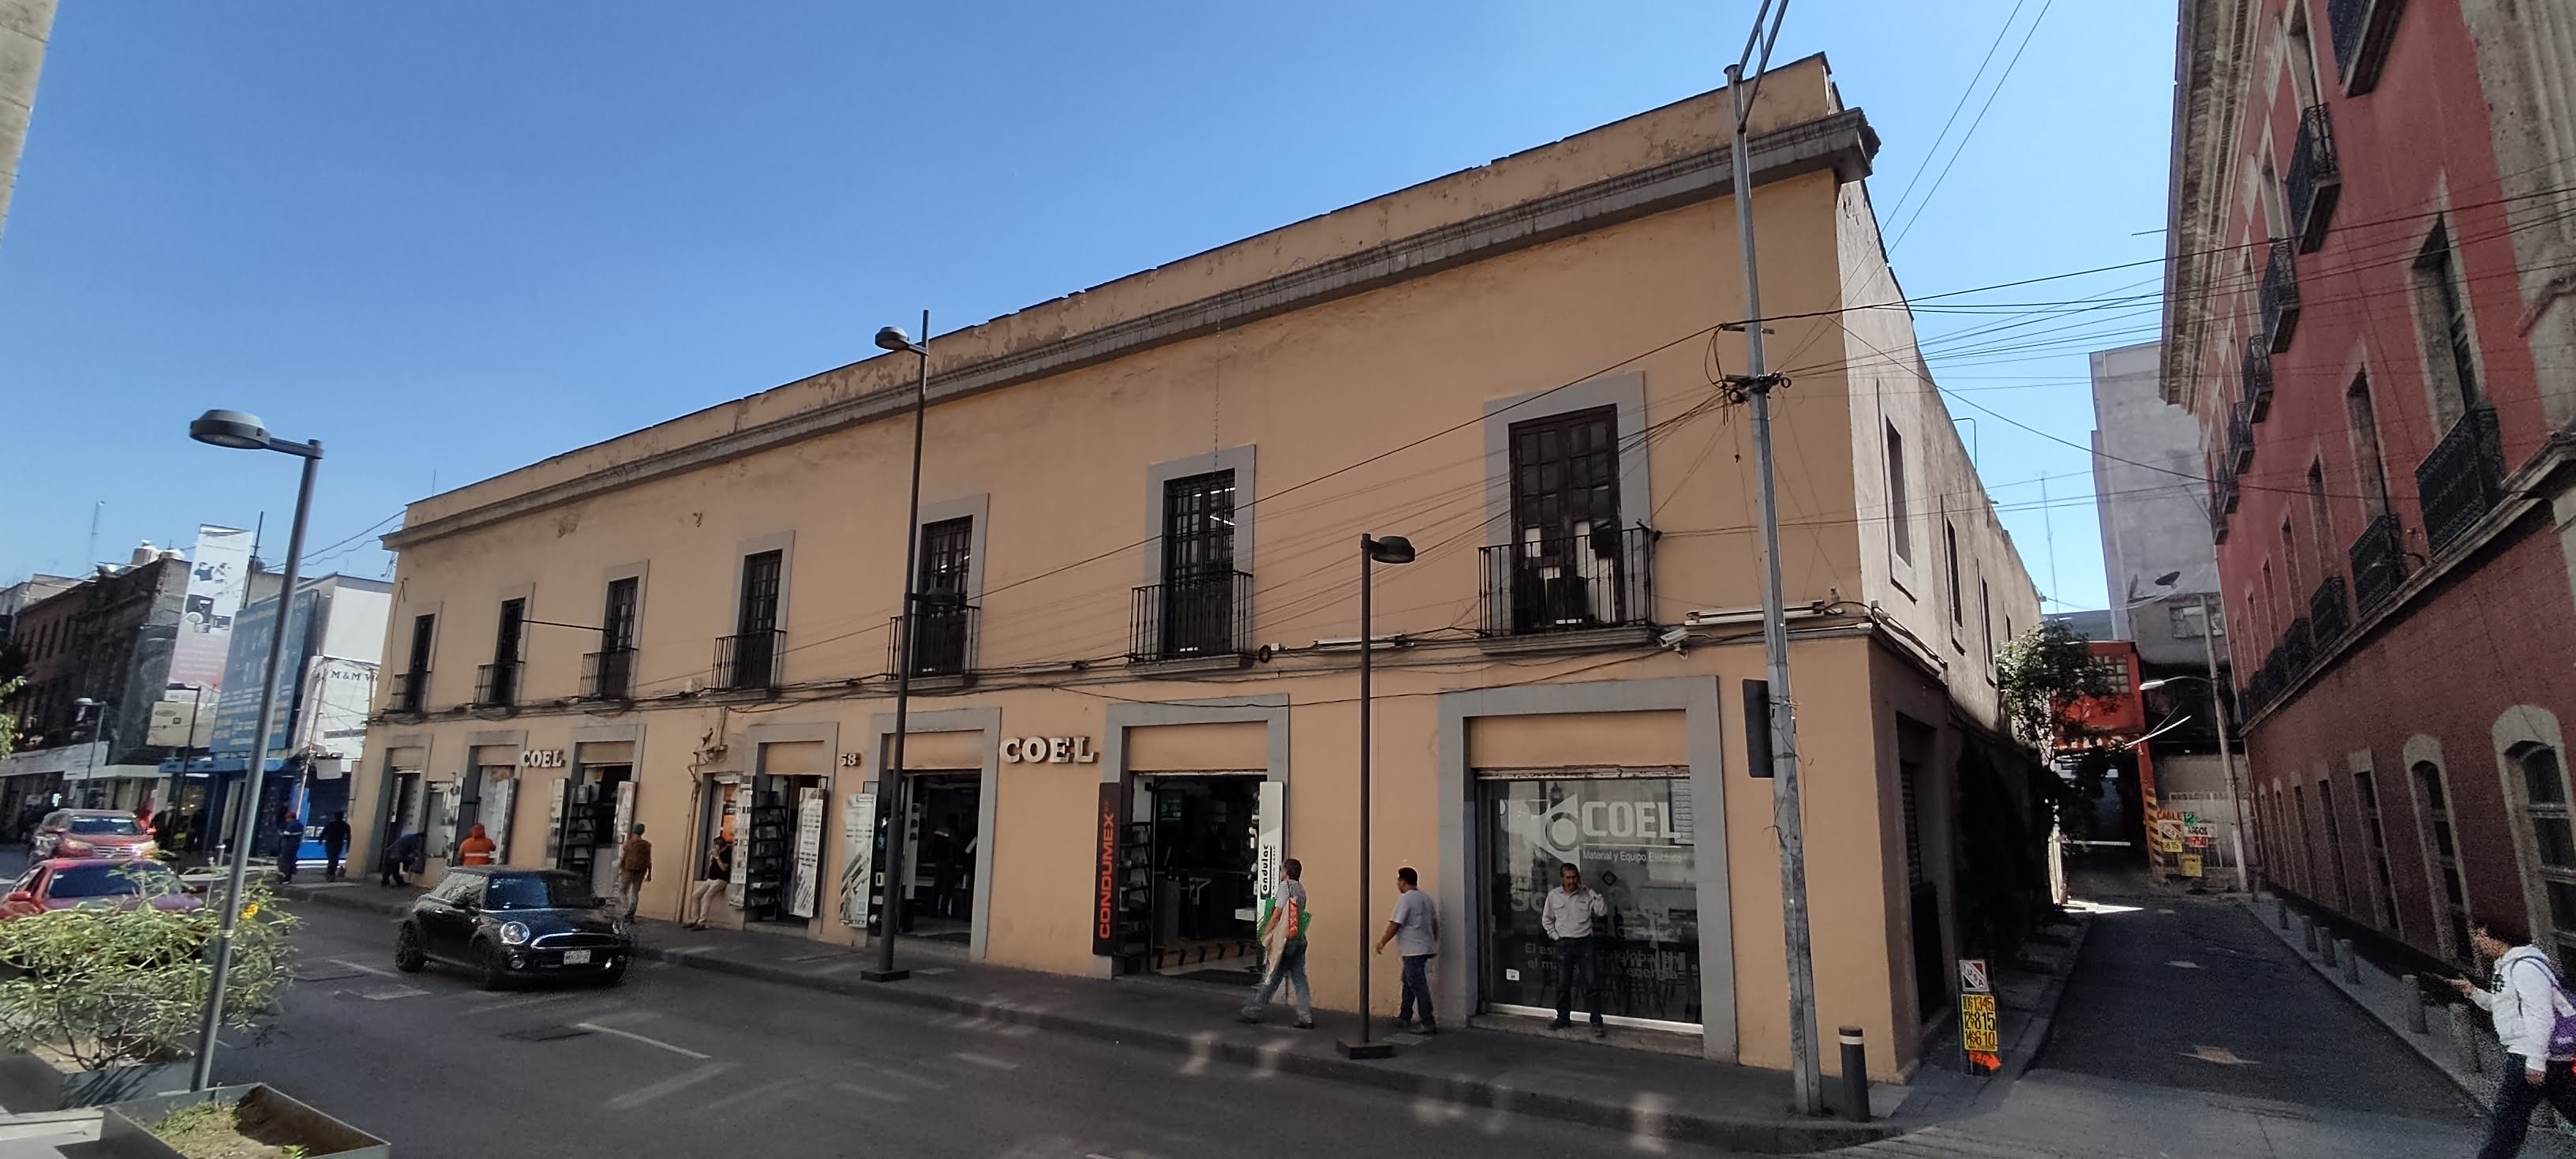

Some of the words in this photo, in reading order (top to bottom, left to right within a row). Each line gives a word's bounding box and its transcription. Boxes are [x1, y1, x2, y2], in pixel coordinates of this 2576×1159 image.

[521, 749, 563, 767] COEL
[840, 753, 857, 766] 58
[999, 736, 1095, 763] COEL
[1582, 801, 1681, 838] COEL
[1582, 850, 1612, 860] Material
[1099, 813, 1114, 939] CONDUMEX
[1963, 964, 1984, 986] IUSA
